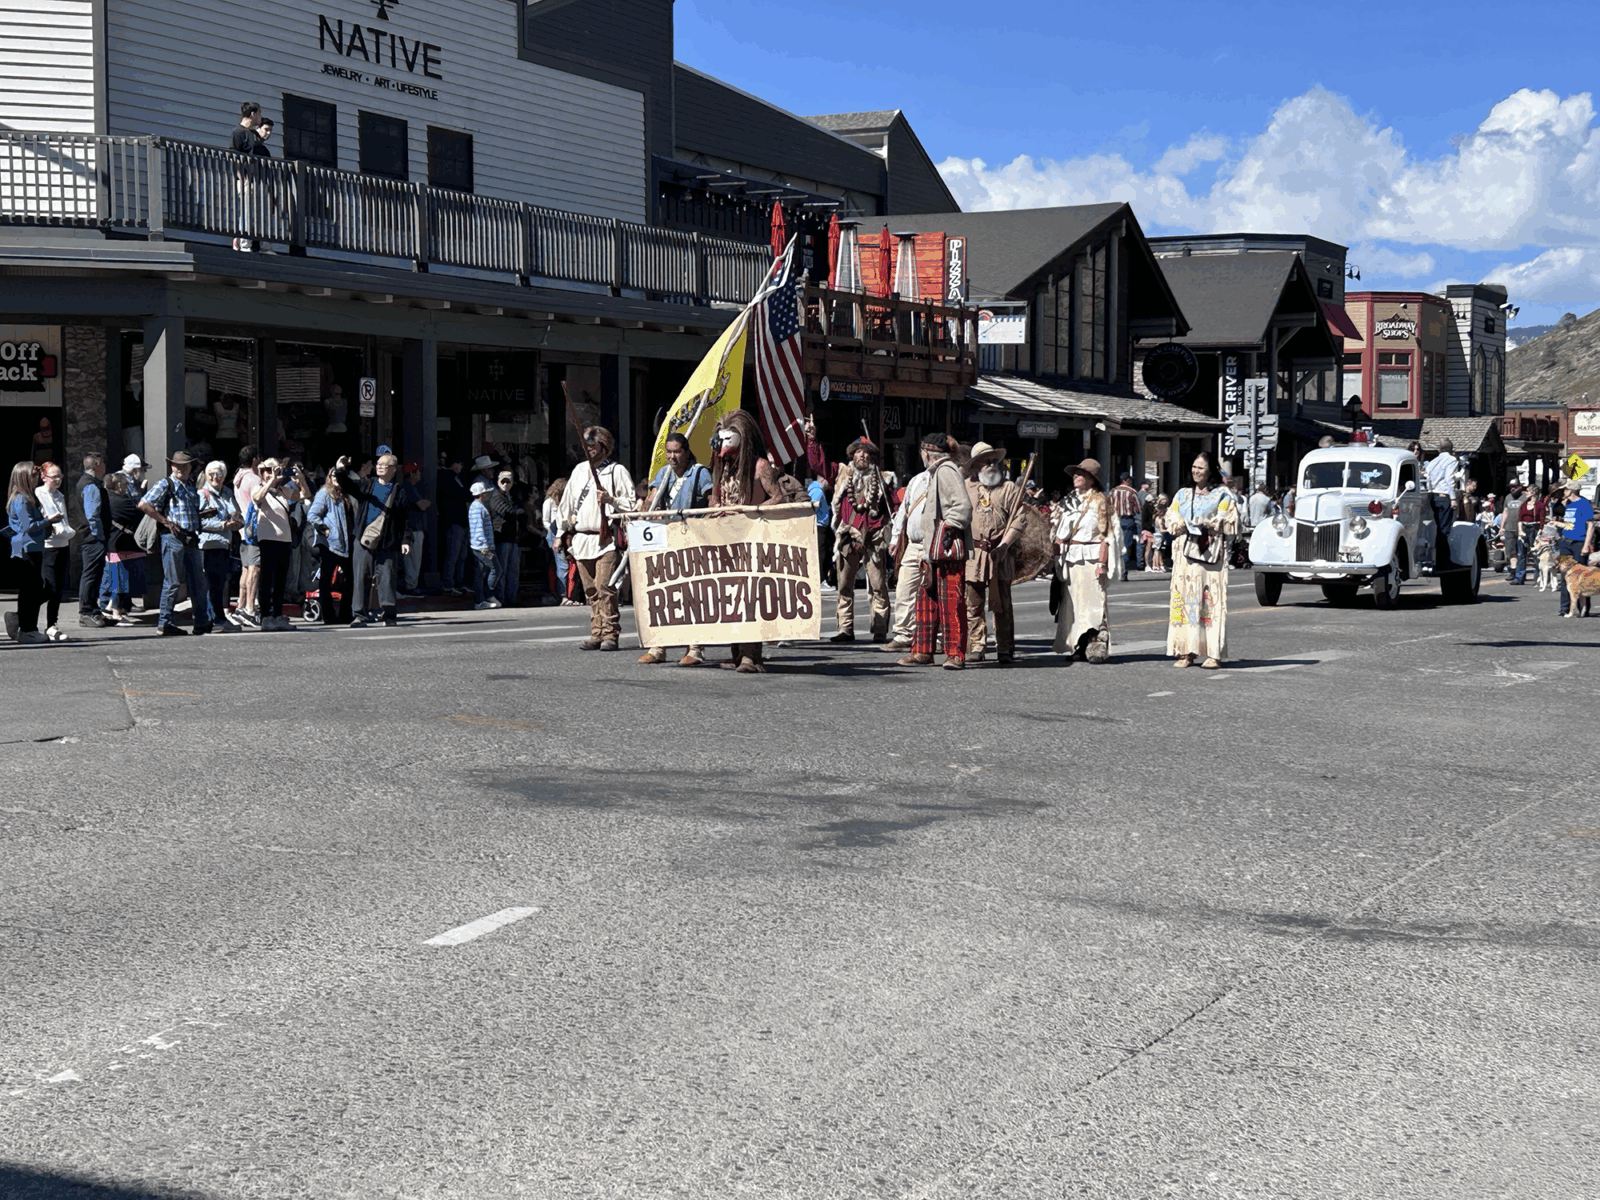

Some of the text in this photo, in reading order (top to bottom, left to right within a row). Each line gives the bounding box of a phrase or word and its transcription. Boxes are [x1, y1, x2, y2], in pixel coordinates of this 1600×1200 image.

[318, 14, 442, 80] NATIVE
[321, 64, 438, 101] JEWELRY ART LIFESTYLE
[948, 239, 962, 300] PIZZA
[1375, 321, 1416, 334] BROADWAY
[1382, 330, 1409, 339] SHOPS
[1, 342, 40, 361] Off
[468, 388, 525, 401] NATIVE
[1225, 356, 1238, 402] RIVER
[643, 526, 653, 541] 6
[645, 542, 809, 587] MOUNTAIN MAN
[647, 577, 813, 627] RENDEZVOUS
